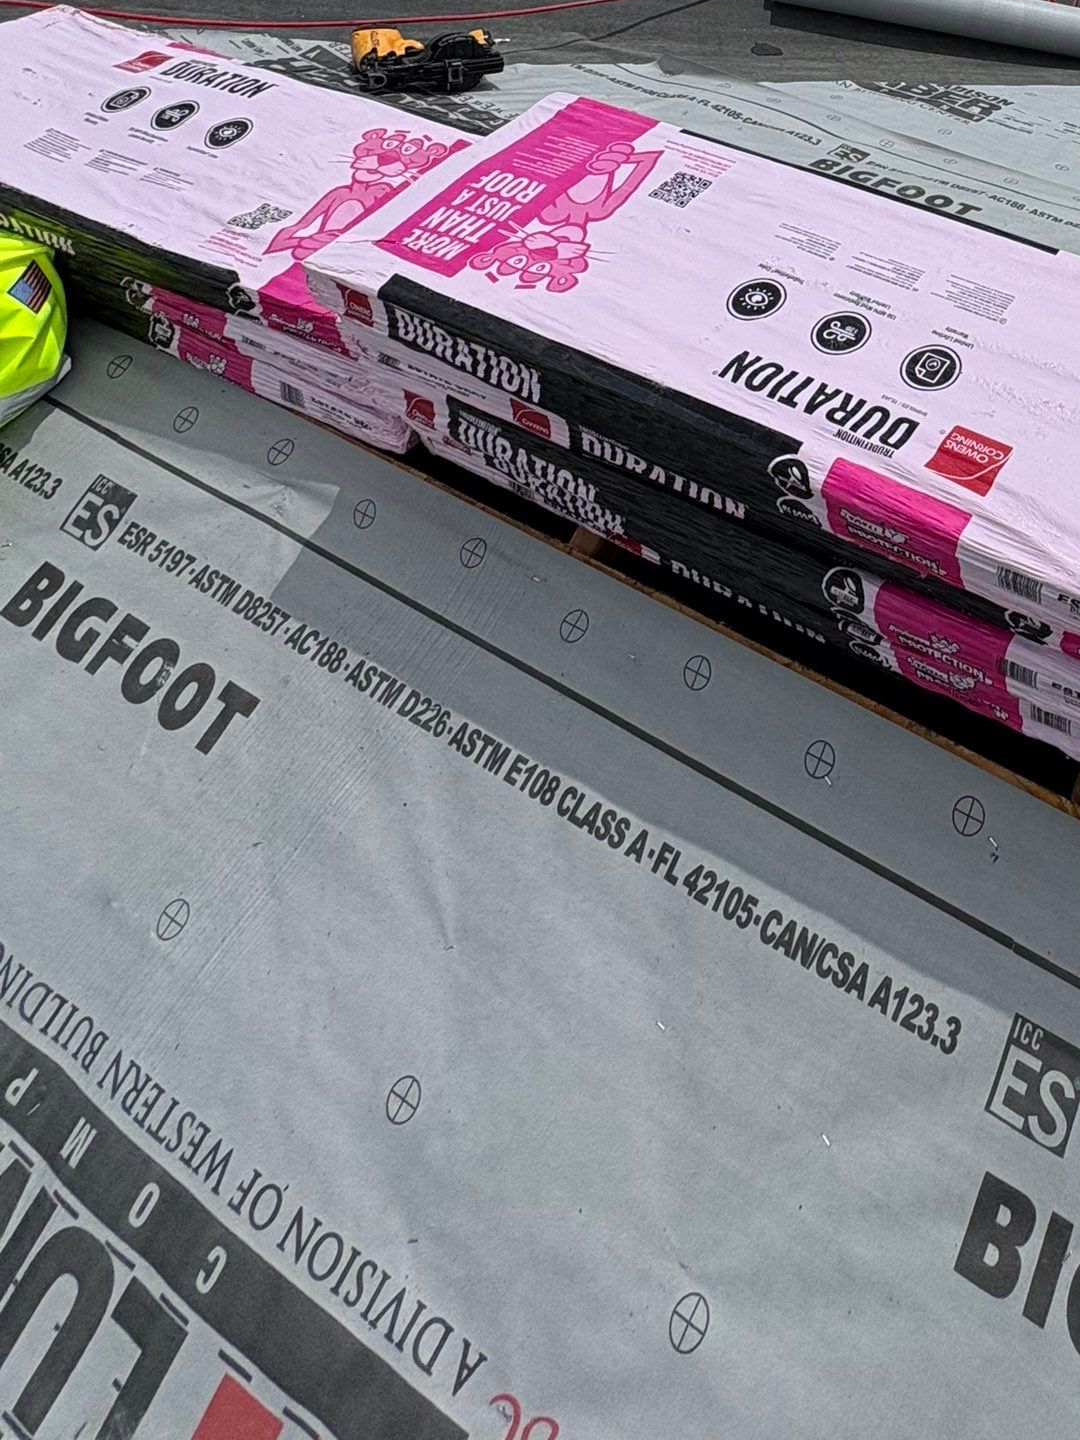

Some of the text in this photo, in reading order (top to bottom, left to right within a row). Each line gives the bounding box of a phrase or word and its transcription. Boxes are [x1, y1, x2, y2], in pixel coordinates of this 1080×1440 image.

[160, 61, 276, 98] DURATION
[451, 189, 522, 222] JUST A
[470, 170, 547, 203] ROOF
[807, 159, 983, 216] BIGFOOT
[403, 228, 470, 261] MORE
[419, 206, 496, 244] THAN
[396, 308, 542, 405] DURATION
[717, 349, 921, 450] DURATION
[457, 417, 598, 503] DURATION
[833, 429, 894, 458] TRUDEFINITION
[944, 438, 988, 463] OWENS
[951, 433, 1003, 460] CORNING
[582, 430, 747, 520] DURATION
[62, 494, 120, 549] ES
[0, 560, 262, 756] BIGFOOT
[117, 521, 157, 558] ESR
[503, 753, 561, 807] E108
[556, 785, 631, 850] CLASS
[867, 975, 962, 1055] A123.3
[1012, 1014, 1044, 1052] ICC
[989, 1046, 1075, 1149] ES
[96, 1048, 489, 1397] A DIVISION OF WESTERN
